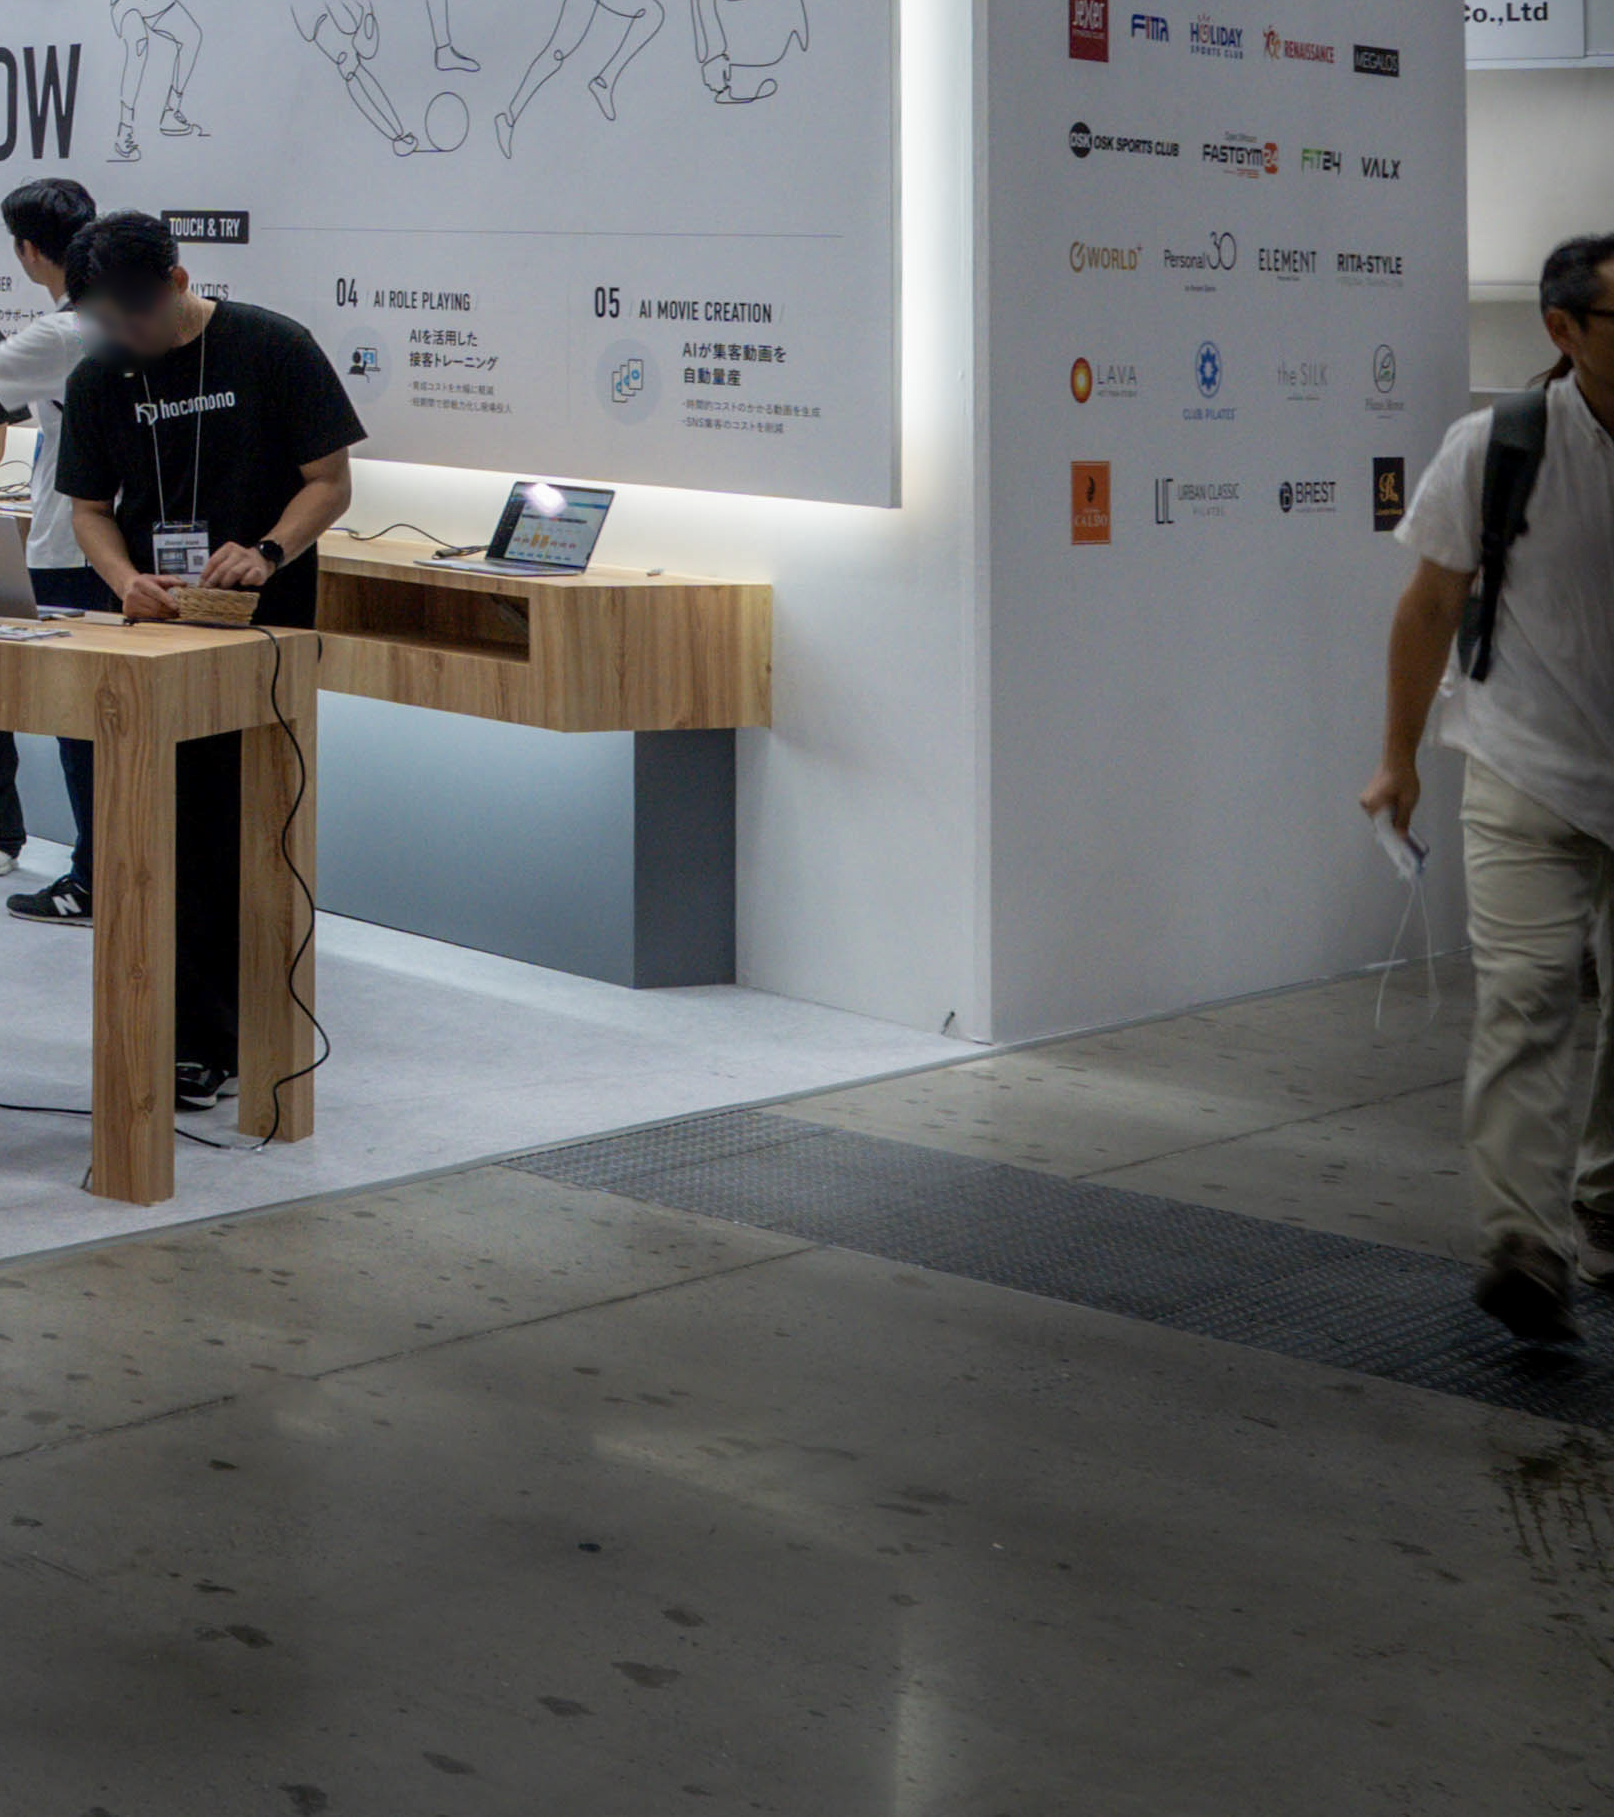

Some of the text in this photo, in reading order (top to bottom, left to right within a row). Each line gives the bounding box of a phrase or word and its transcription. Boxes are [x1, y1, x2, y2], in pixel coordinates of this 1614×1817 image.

[1189, 21, 1244, 49] HOLIDAY
[168, 216, 241, 238] TOUCH & TRY
[1258, 247, 1318, 274] ELEMENT
[1336, 252, 1403, 276] RITA-STYLE
[336, 277, 358, 308] 04
[373, 290, 471, 312] AI ROLE PLAYING
[594, 286, 621, 319] 05
[639, 299, 772, 324] AI MOVIE CREATION
[409, 328, 479, 348] AIを活用した
[409, 351, 500, 372] 接客トレーニング
[682, 342, 787, 364] AIが集客動画を
[683, 366, 742, 387] 自動量産
[1096, 364, 1138, 386] LAVA
[1295, 480, 1337, 504] BREST
